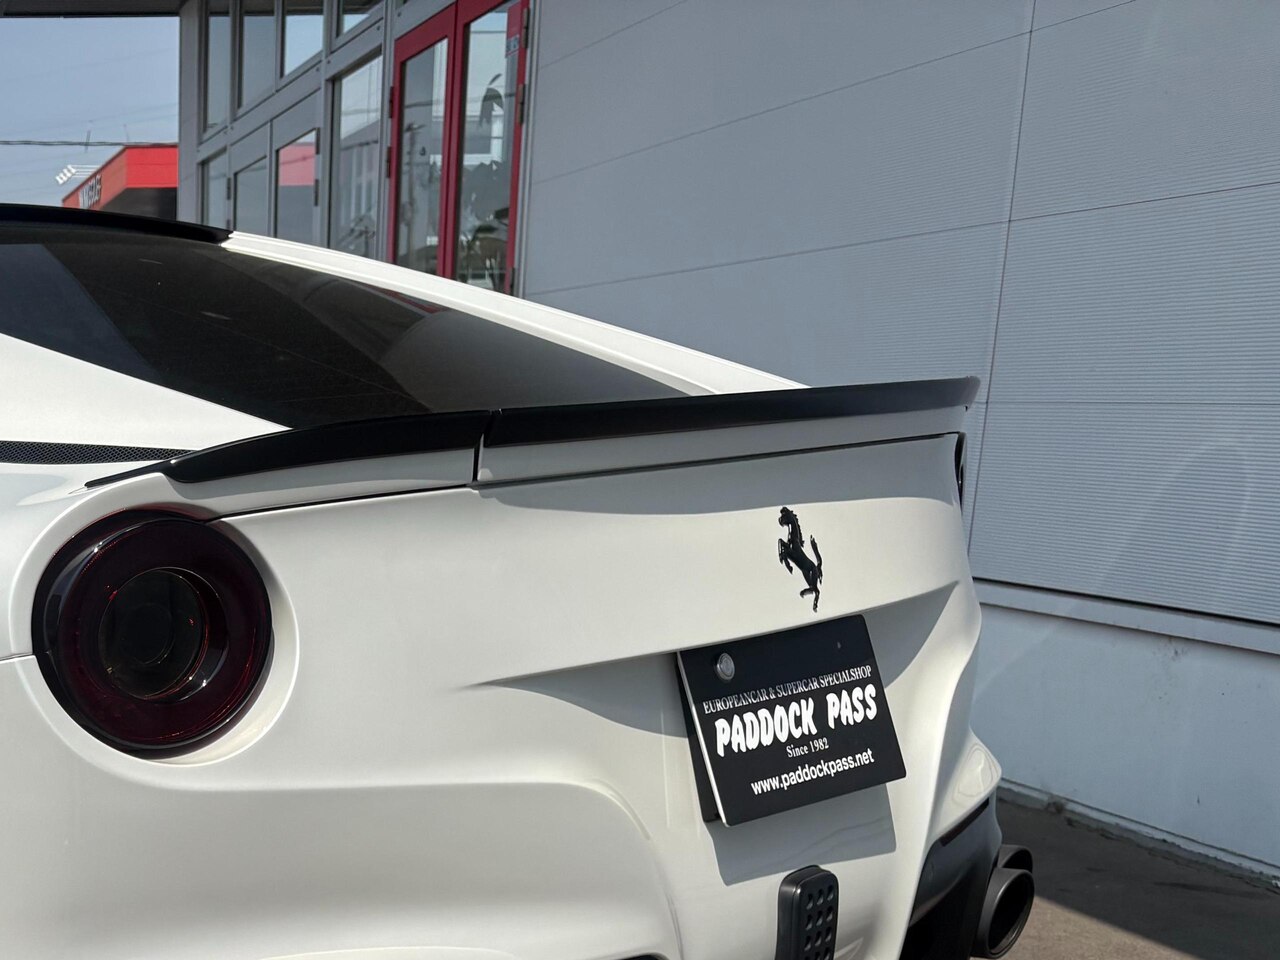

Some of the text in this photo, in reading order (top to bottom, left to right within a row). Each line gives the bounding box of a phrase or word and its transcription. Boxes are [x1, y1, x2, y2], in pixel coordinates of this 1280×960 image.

[703, 665, 872, 714] EUROPEANCAR & SUPERCAR SPECIALSHOP
[714, 683, 878, 758] PADDOCK PASS
[750, 748, 875, 795] www.paddockpass.net
[786, 737, 829, 758] Since 1982
